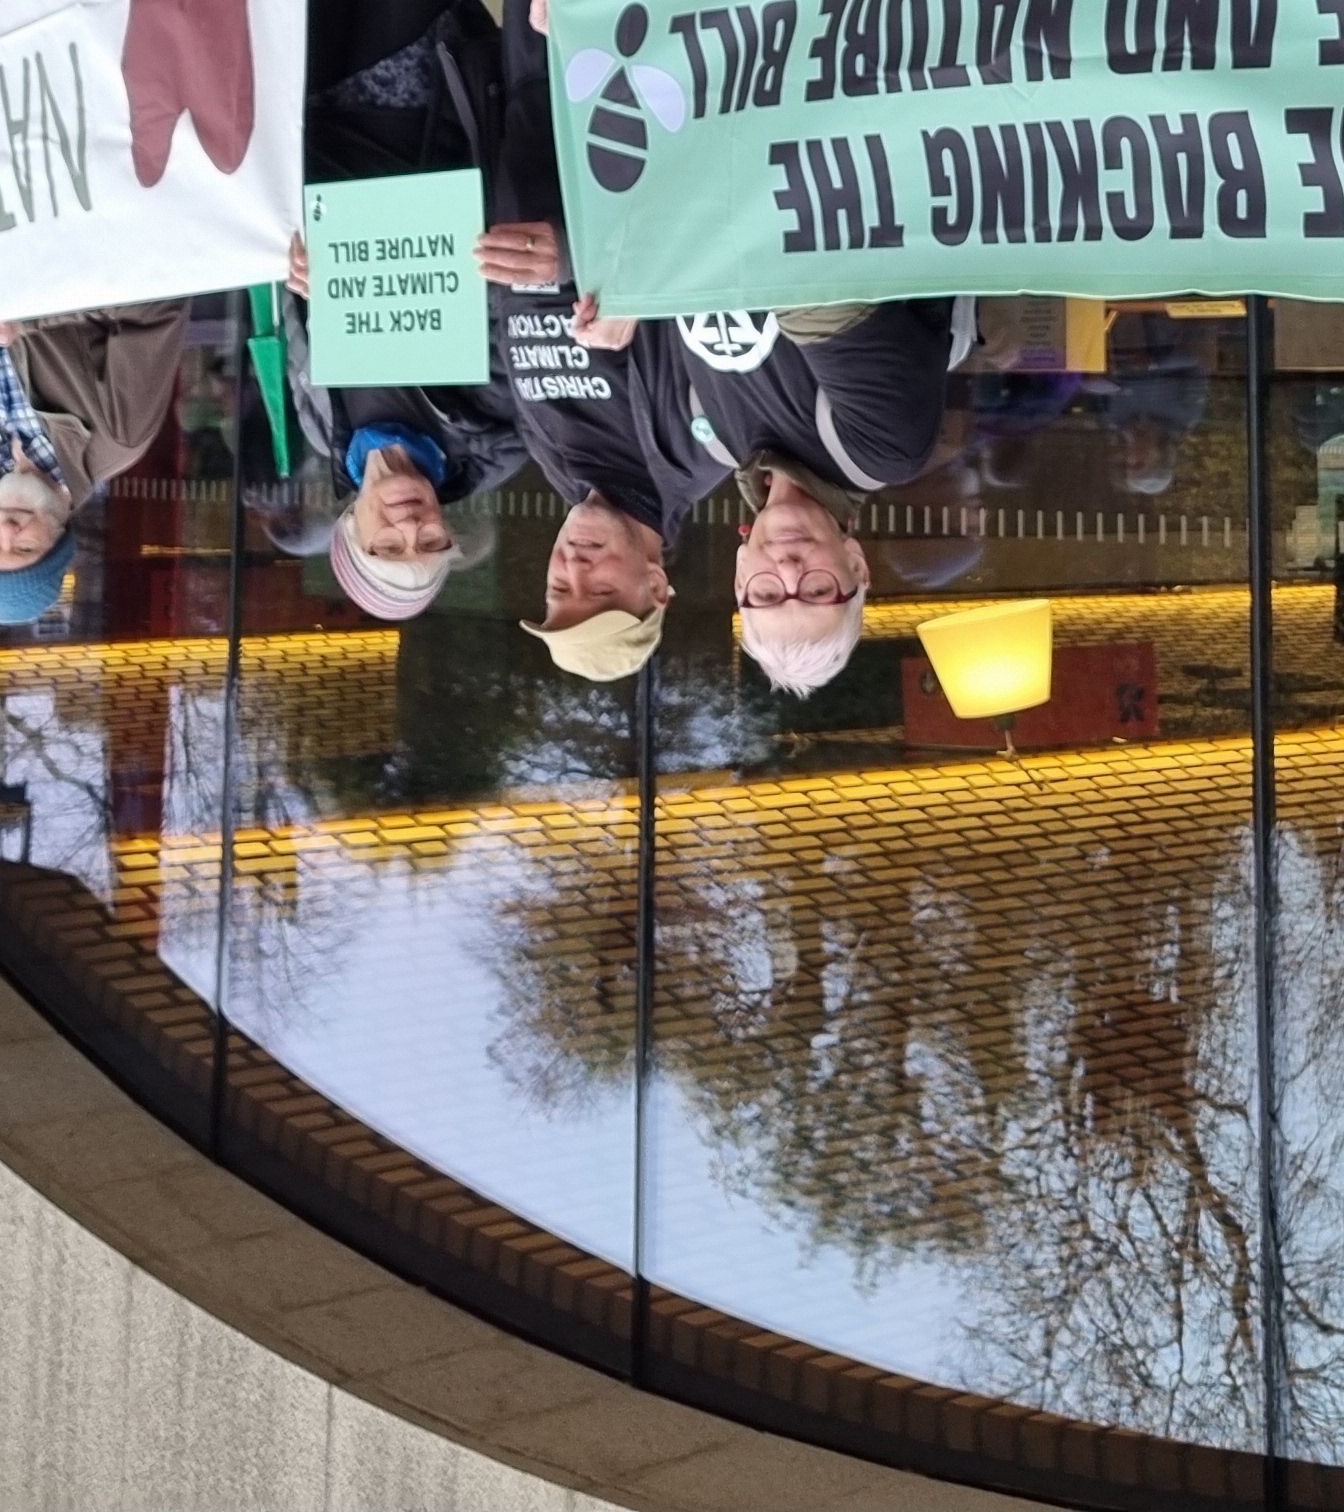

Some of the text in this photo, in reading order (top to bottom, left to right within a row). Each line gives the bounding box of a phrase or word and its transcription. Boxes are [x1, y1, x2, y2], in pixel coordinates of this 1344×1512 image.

[922, 110, 1267, 246] BACKING
[768, 133, 904, 253] THE
[328, 233, 454, 263] NATURE BILL
[327, 271, 459, 299] CLIMATE AND
[345, 309, 442, 334] BACK THE
[507, 314, 575, 338] ACTION
[509, 345, 590, 370] CLIMATE
[514, 375, 611, 402] CHRISTIA
